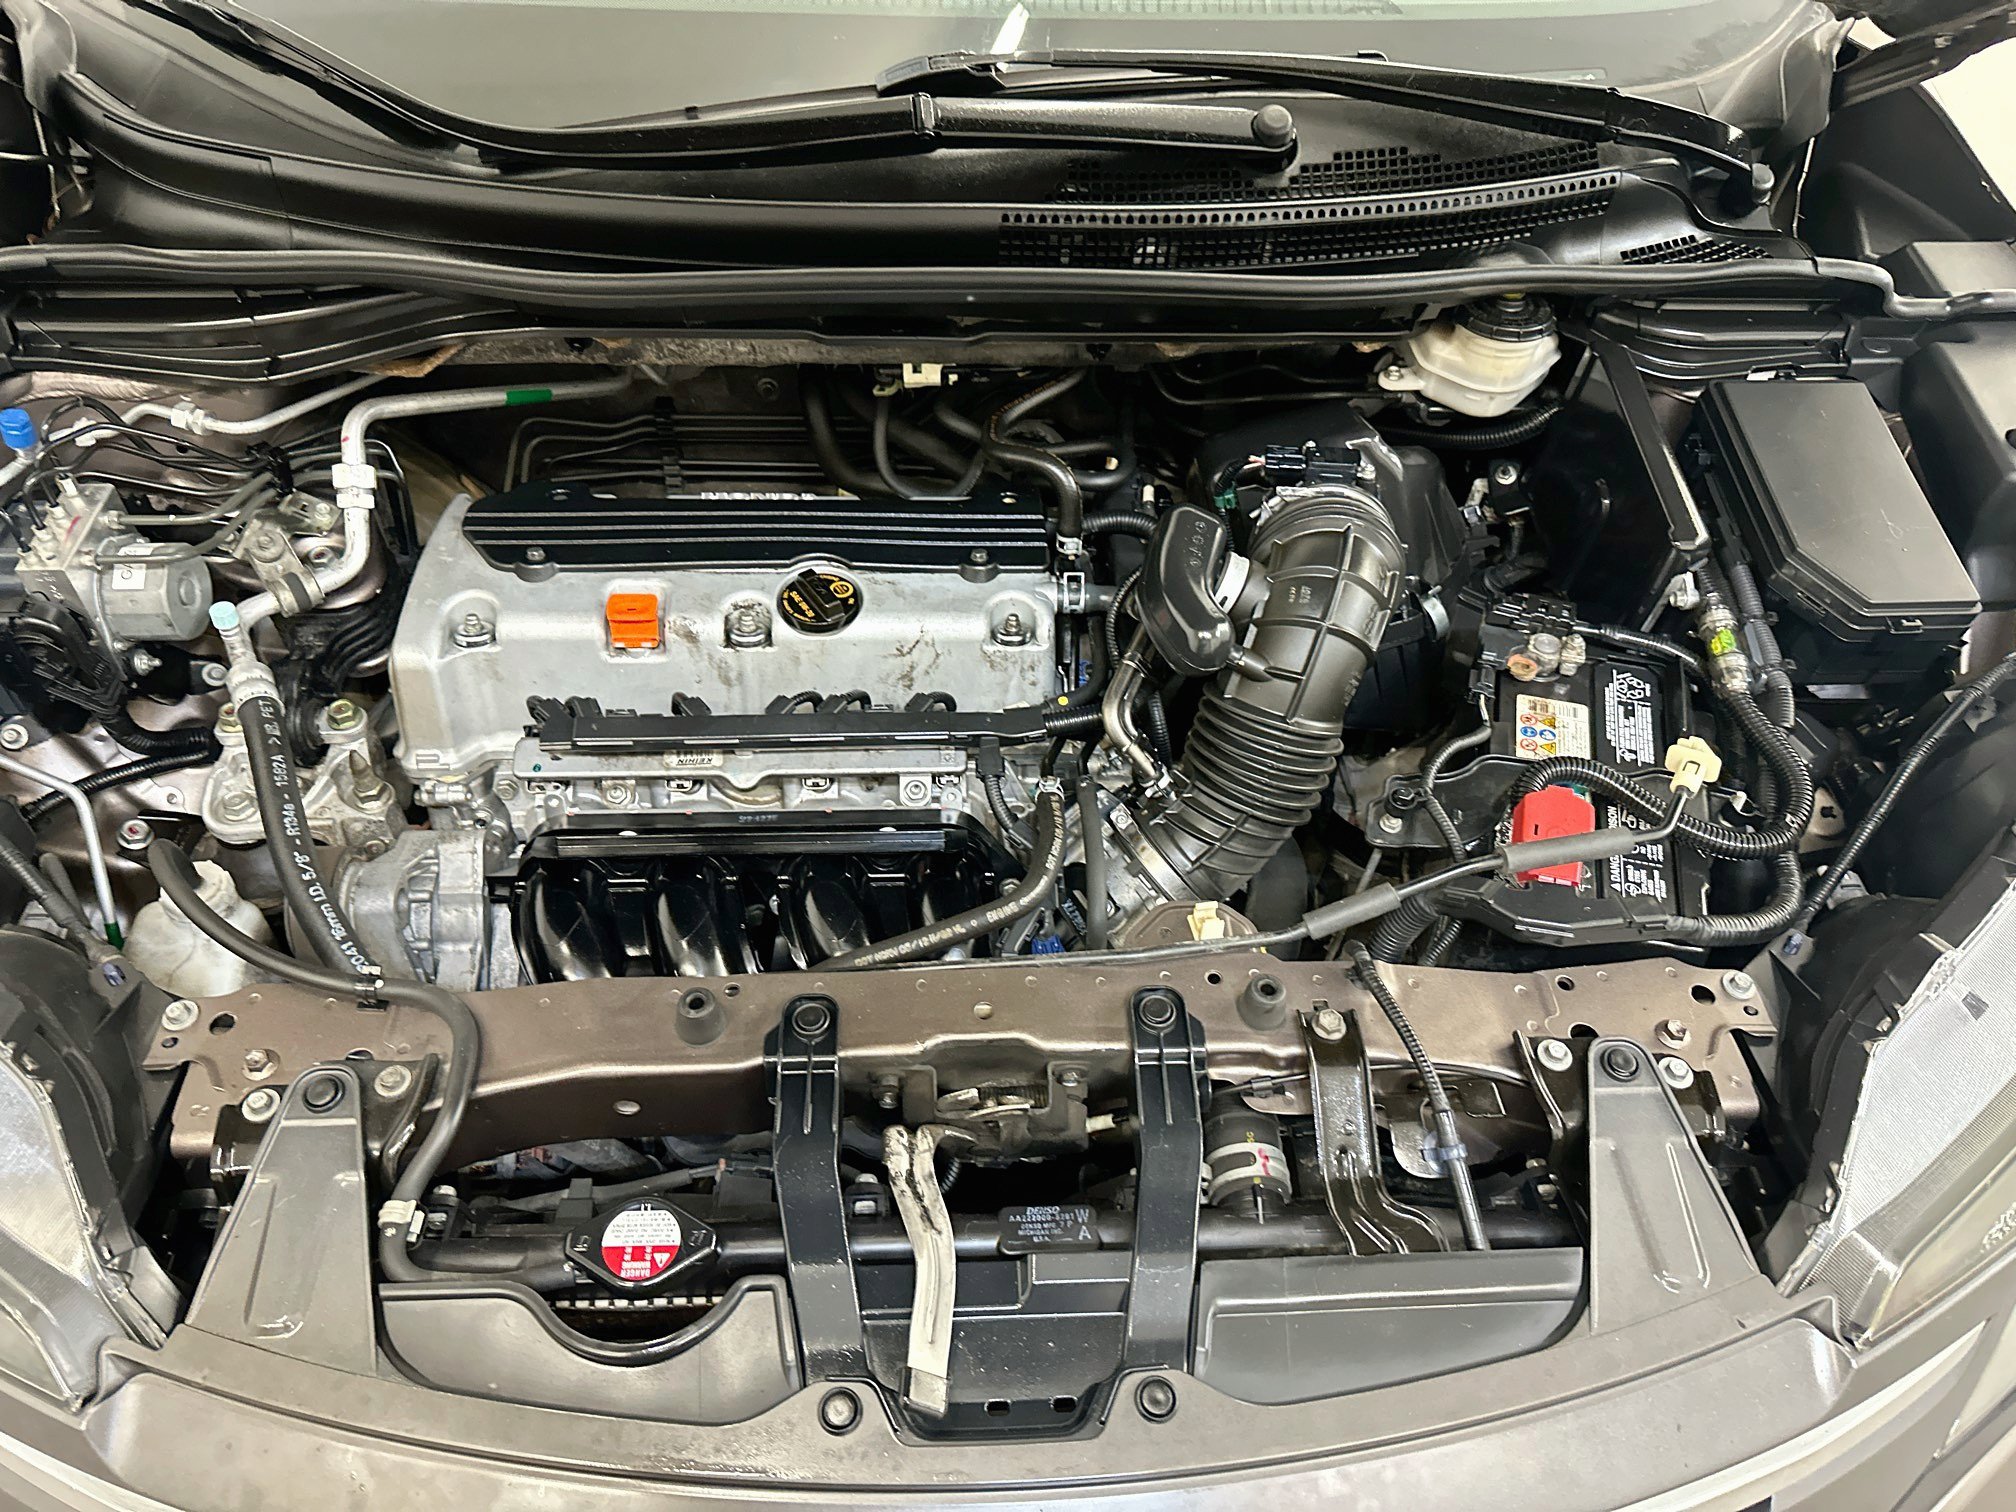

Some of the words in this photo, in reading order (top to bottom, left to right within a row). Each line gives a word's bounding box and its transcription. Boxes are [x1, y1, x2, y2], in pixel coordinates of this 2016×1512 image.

[270, 754, 289, 788] 1582A
[320, 903, 347, 941] 16mm
[1026, 1206, 1060, 1216] DENSO
[1078, 1225, 1092, 1241] A
[620, 1269, 651, 1278] DANGER
